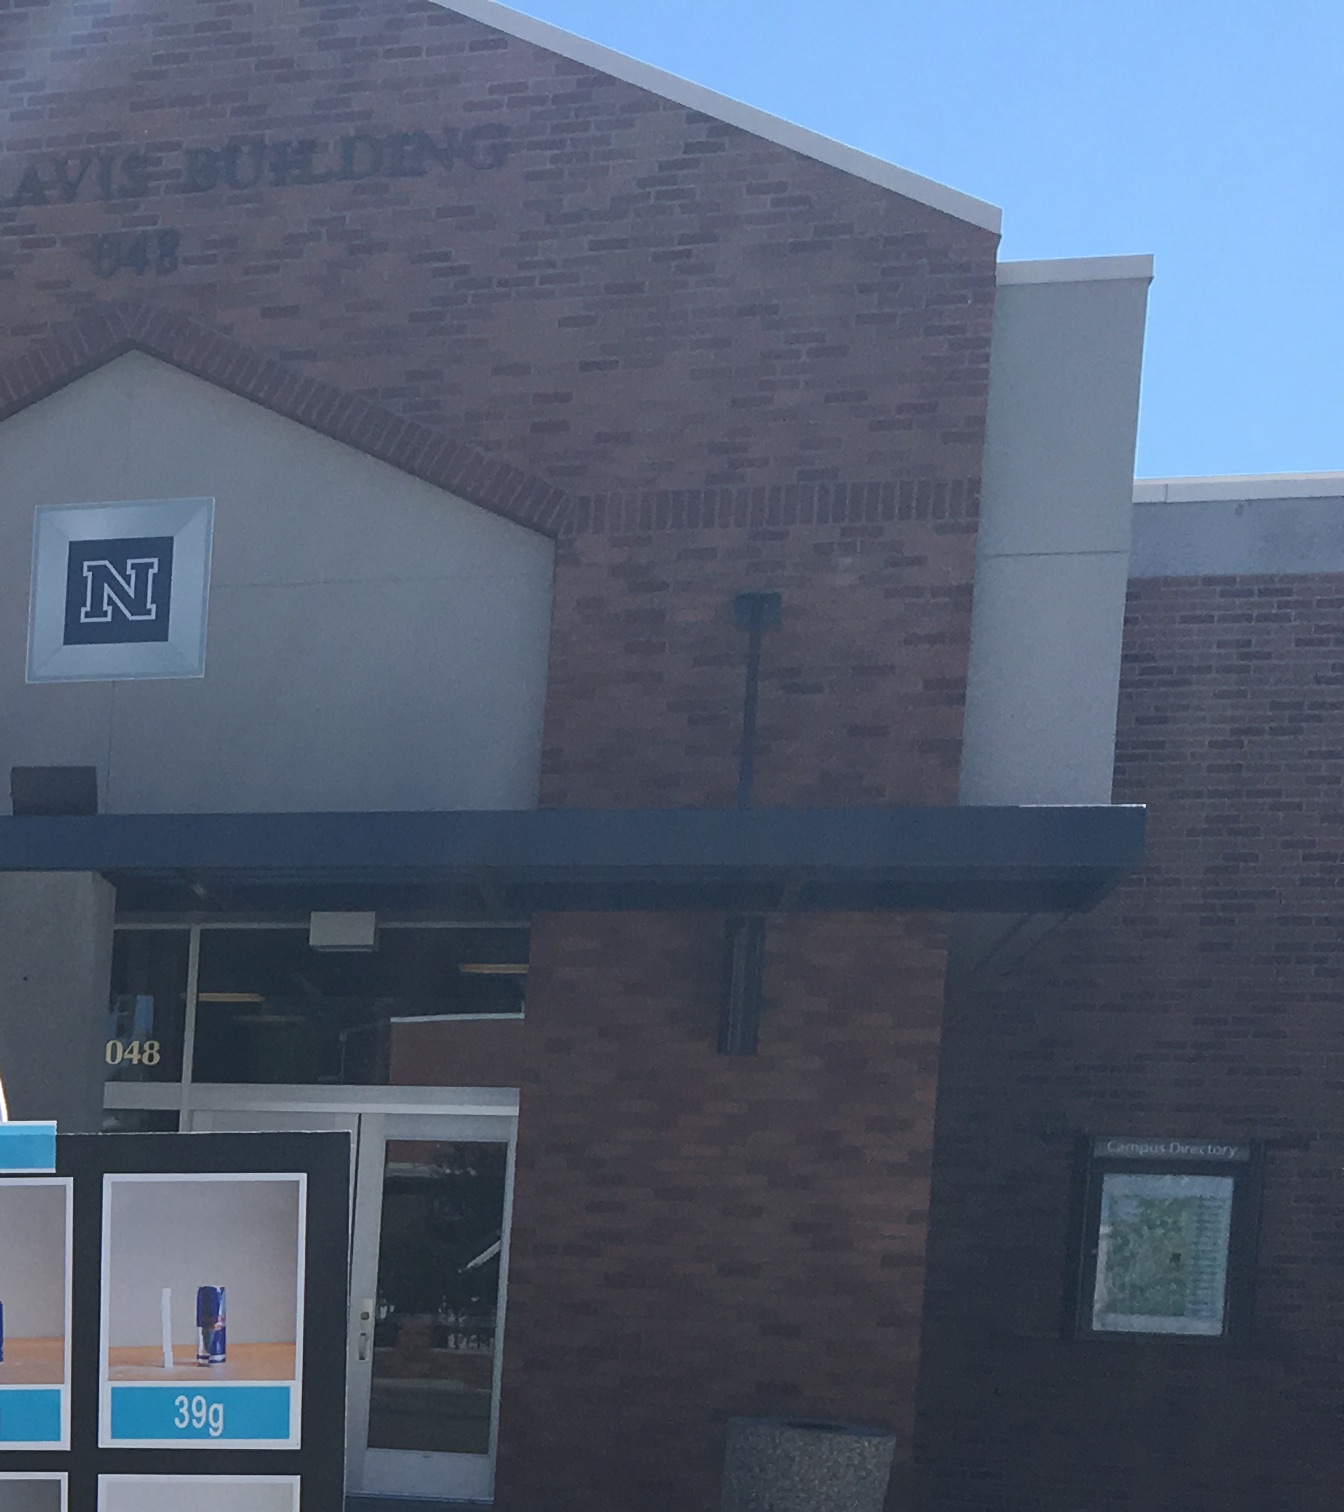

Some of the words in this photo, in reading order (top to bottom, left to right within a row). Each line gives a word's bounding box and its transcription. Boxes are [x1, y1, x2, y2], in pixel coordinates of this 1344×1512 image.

[180, 122, 512, 195] BUILDING
[79, 557, 159, 623] N
[104, 1038, 161, 1067] 048
[1106, 1140, 1166, 1156] Campus
[1169, 1141, 1238, 1159] Directory
[174, 1395, 224, 1437] 39g
